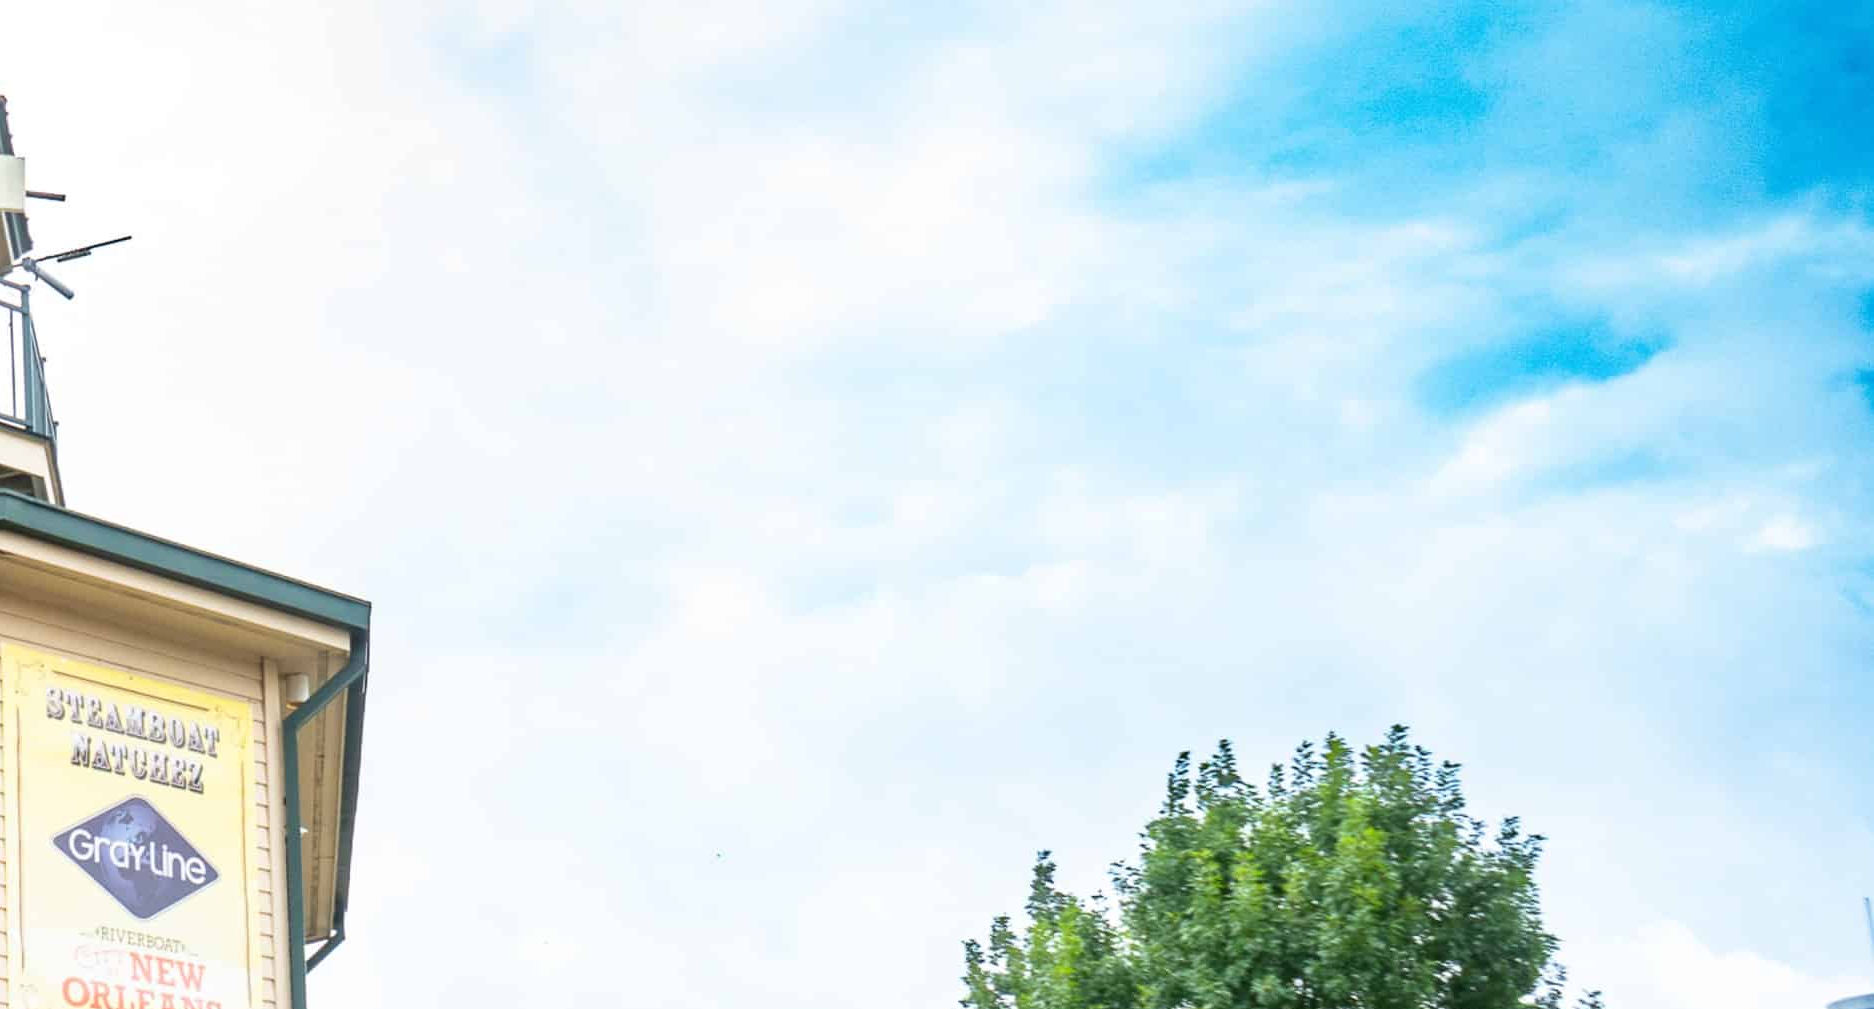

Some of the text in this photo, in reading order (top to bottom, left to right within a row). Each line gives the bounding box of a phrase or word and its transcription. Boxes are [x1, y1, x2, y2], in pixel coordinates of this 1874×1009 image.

[45, 686, 221, 759] STEAMBOAT
[71, 733, 204, 795] NATCHEZ
[101, 926, 182, 953] RIVERBOAT
[129, 951, 206, 992] NEW
